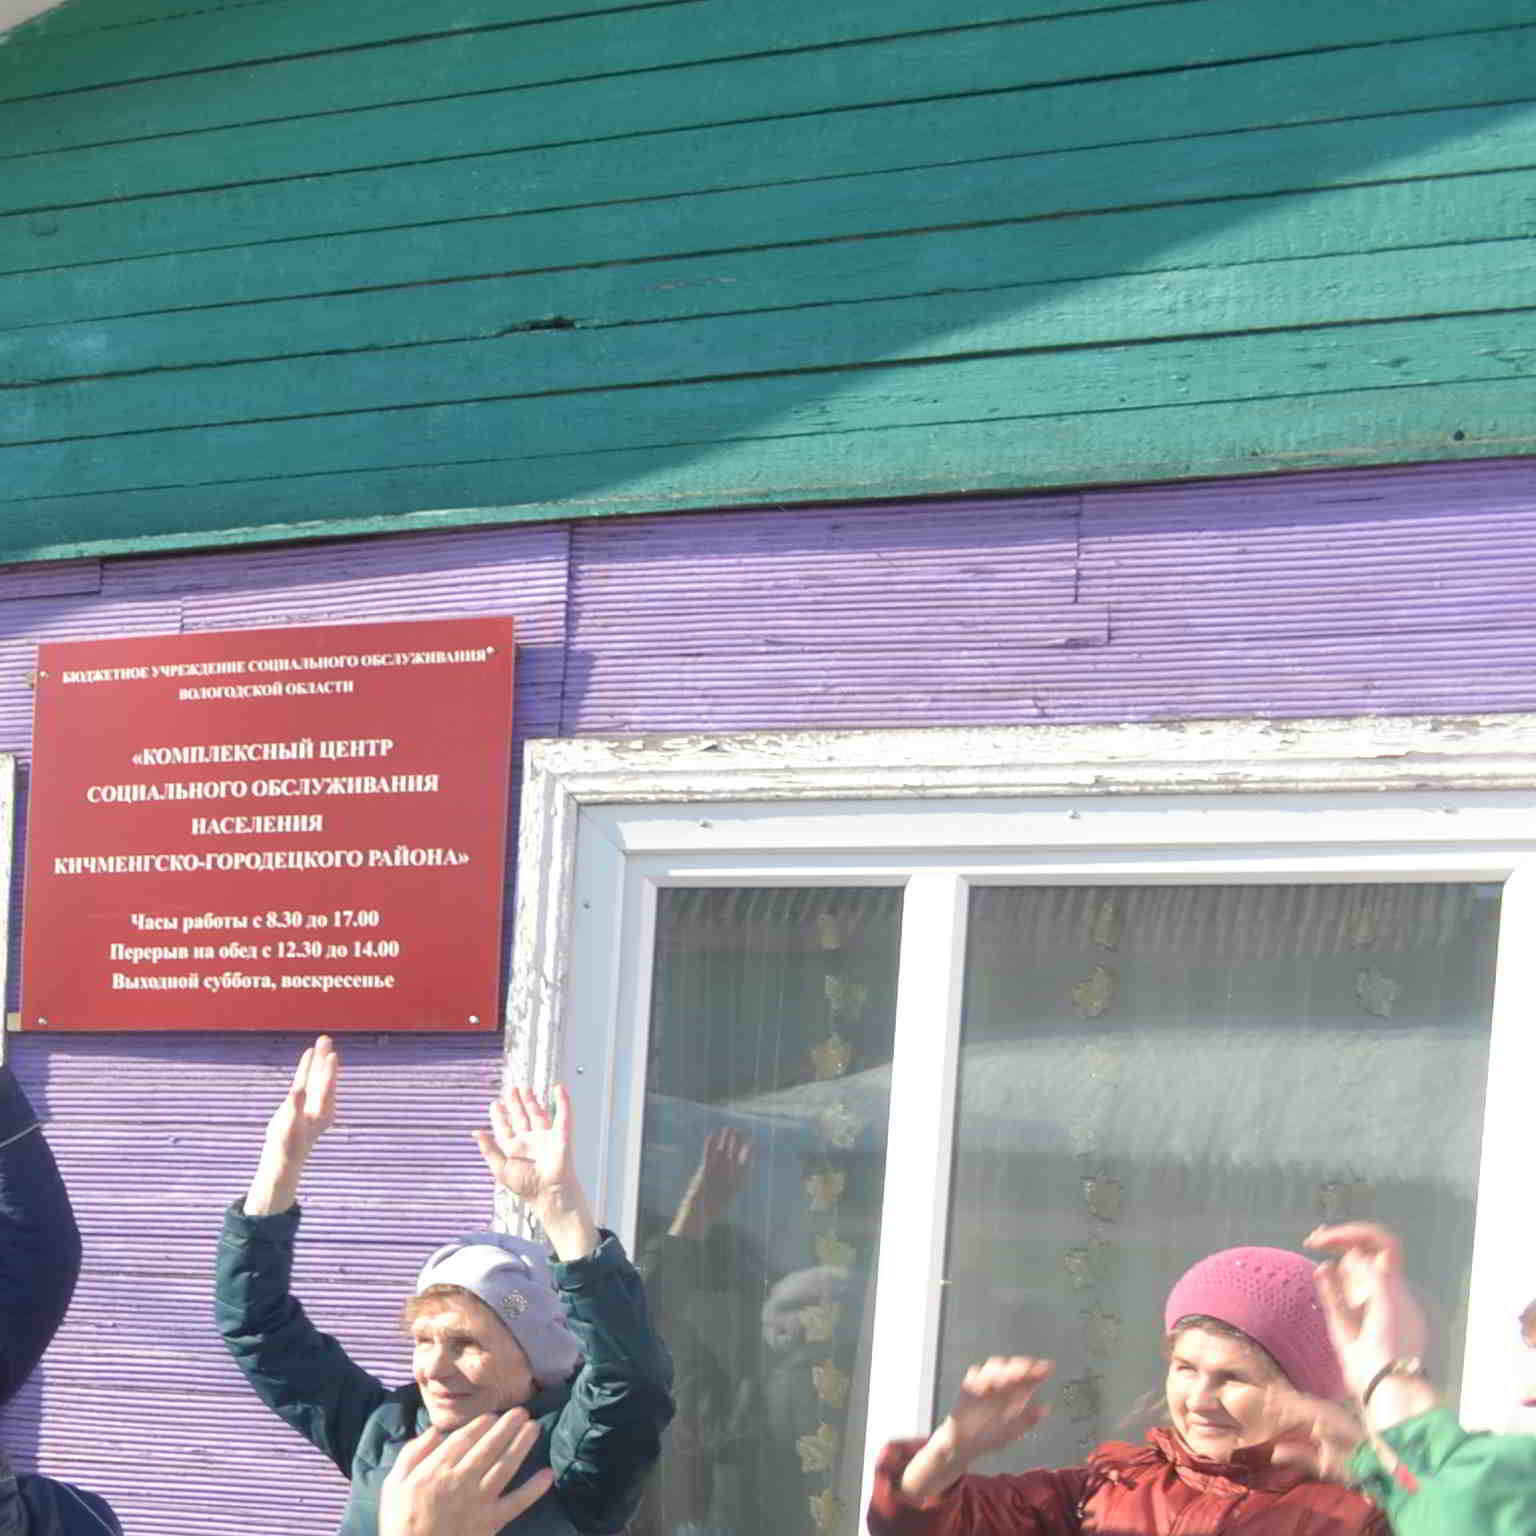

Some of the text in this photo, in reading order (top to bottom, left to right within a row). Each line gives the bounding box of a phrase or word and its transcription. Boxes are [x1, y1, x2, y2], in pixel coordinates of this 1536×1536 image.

[62, 650, 487, 683] БЮДЖЕТНОЕ УЧРЕЖДЕНИЕ СОЦИАЛЬНОГО ОБСЛУЖИВАНИЯ
[179, 680, 354, 700] ВОЛОГОДСКОЙ ОБЛАСТИ
[132, 738, 394, 765] «КОМПЛЕКСНЫЙ ЦЕНТР
[87, 774, 438, 803] СОЦИАЛЬНОГО ОБСЛУЖИВАНИЯ
[192, 814, 323, 835] НАСЕЛЕНИЯ
[54, 845, 469, 874] КИЧМЕНГСКО-ГОРОДЕЦКОГО РАЙОНА»
[131, 910, 379, 934] Часы работы с 8.30 до 17.00
[110, 941, 399, 964] Перерыв на обед с 12.30 до 14.00
[112, 972, 394, 992] Выходной суббота, воскресенье
